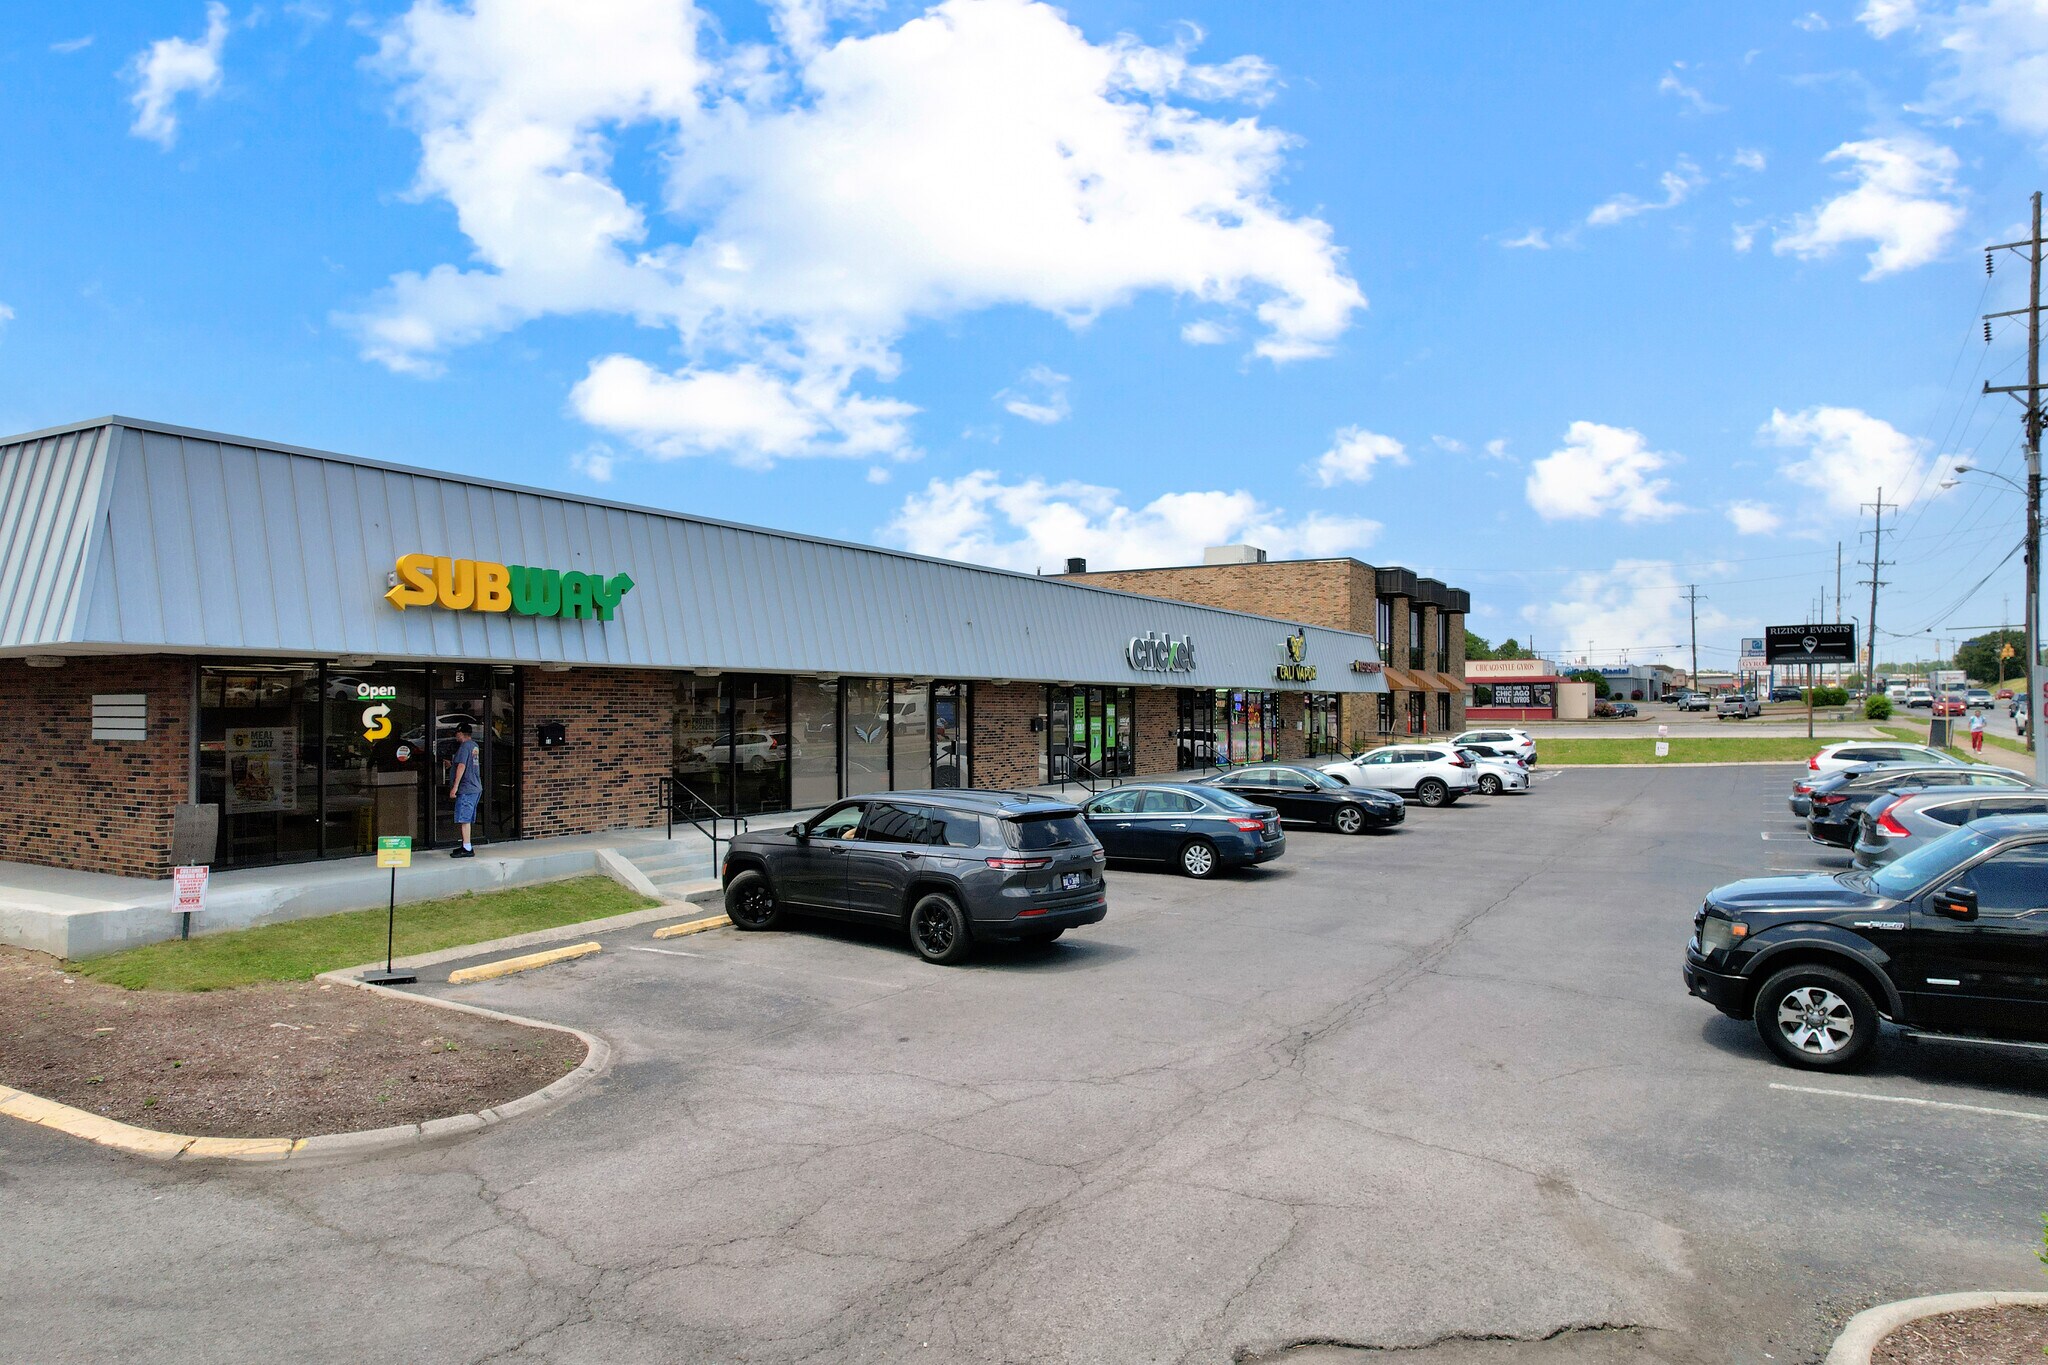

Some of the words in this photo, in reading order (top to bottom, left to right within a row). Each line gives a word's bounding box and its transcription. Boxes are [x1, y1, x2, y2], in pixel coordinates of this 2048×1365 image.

[384, 552, 636, 621] SUBWAY
[1770, 627, 1805, 635] RIZING
[1809, 625, 1851, 634] EVENTS
[1128, 630, 1197, 672] cricket
[1476, 664, 1499, 672] CHICAGO
[1499, 663, 1515, 671] STYLE
[1516, 663, 1535, 671] GYROS
[1278, 665, 1295, 681] CALI
[1296, 665, 1317, 681] VAPOR
[357, 683, 396, 700] Open
[1495, 696, 1511, 704] STYLE
[1513, 696, 1530, 704] GYROS
[250, 730, 274, 740] MEAL
[257, 739, 274, 748] DAY
